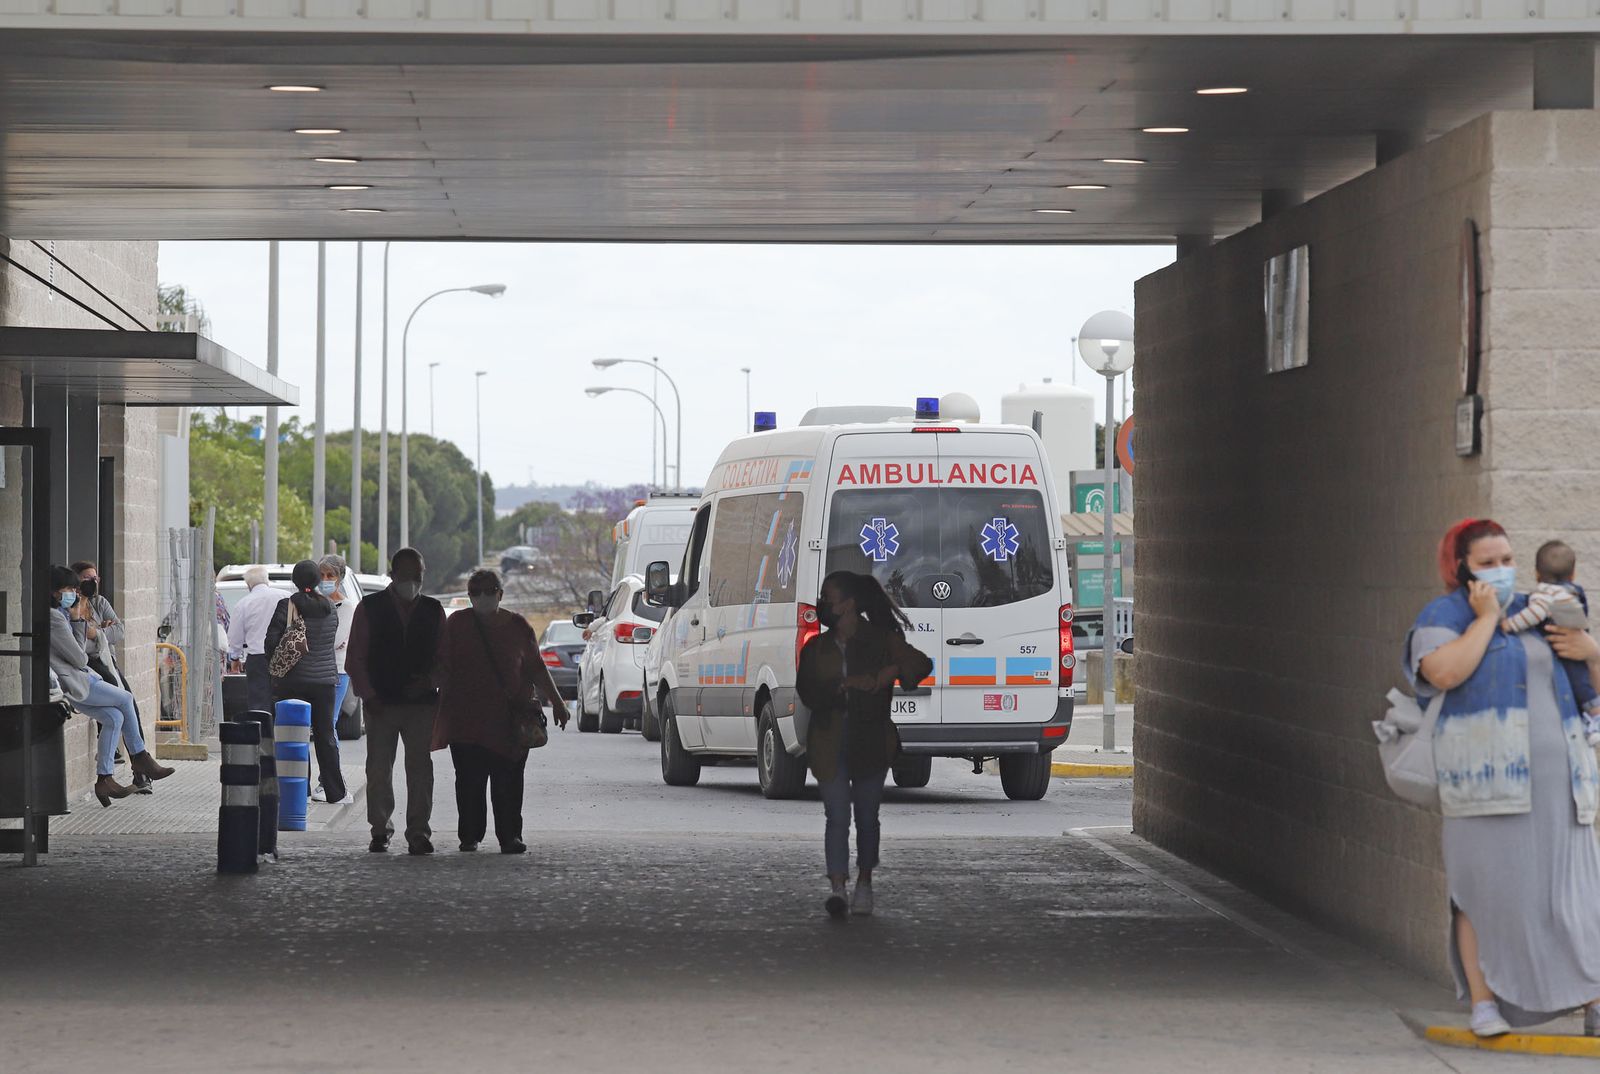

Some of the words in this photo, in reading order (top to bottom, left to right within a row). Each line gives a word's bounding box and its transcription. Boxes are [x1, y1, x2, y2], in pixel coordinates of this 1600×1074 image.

[721, 458, 780, 488] COLECTIVA
[837, 463, 1038, 485] AMBULANCIA
[918, 623, 935, 632] S.L.
[1020, 645, 1037, 654] 557
[892, 701, 916, 713] JKB
